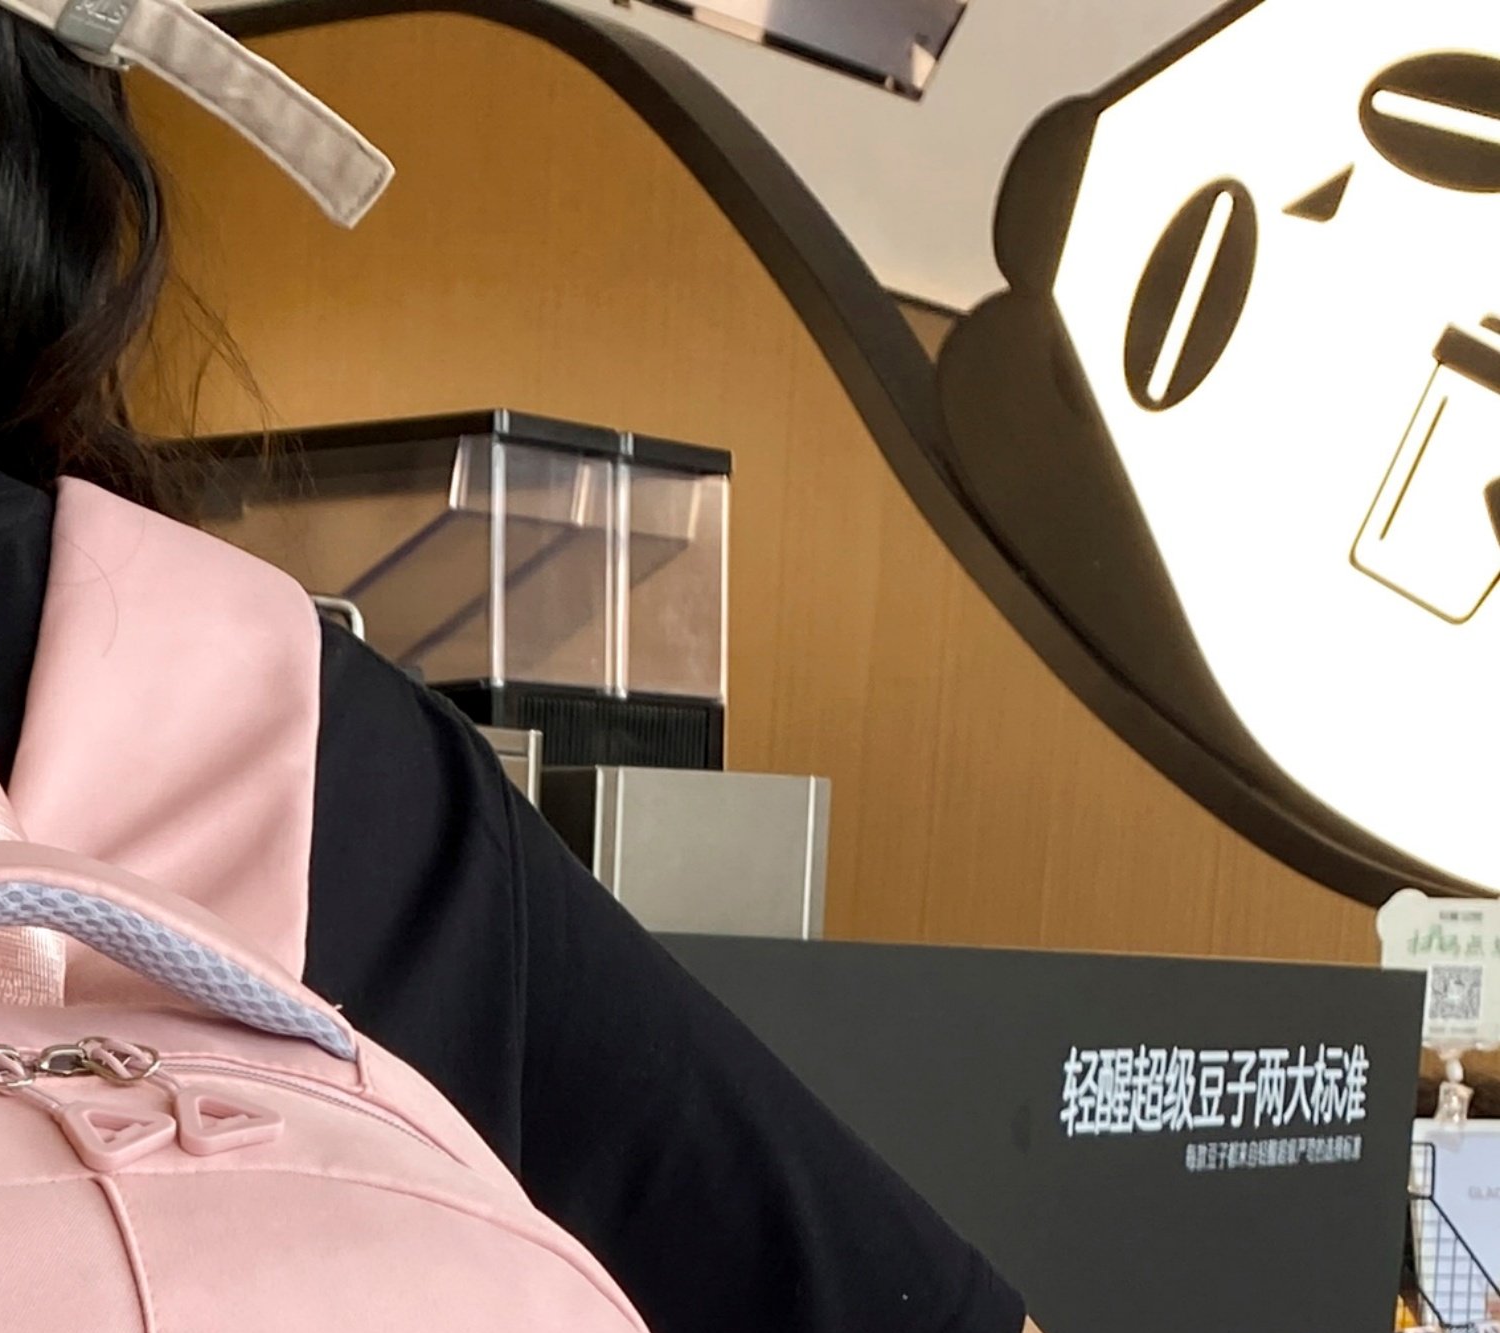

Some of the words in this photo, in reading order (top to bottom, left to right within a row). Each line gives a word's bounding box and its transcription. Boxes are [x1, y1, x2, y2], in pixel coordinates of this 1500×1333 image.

[1060, 1043, 1370, 1136] 轻醒超级豆子两大标准
